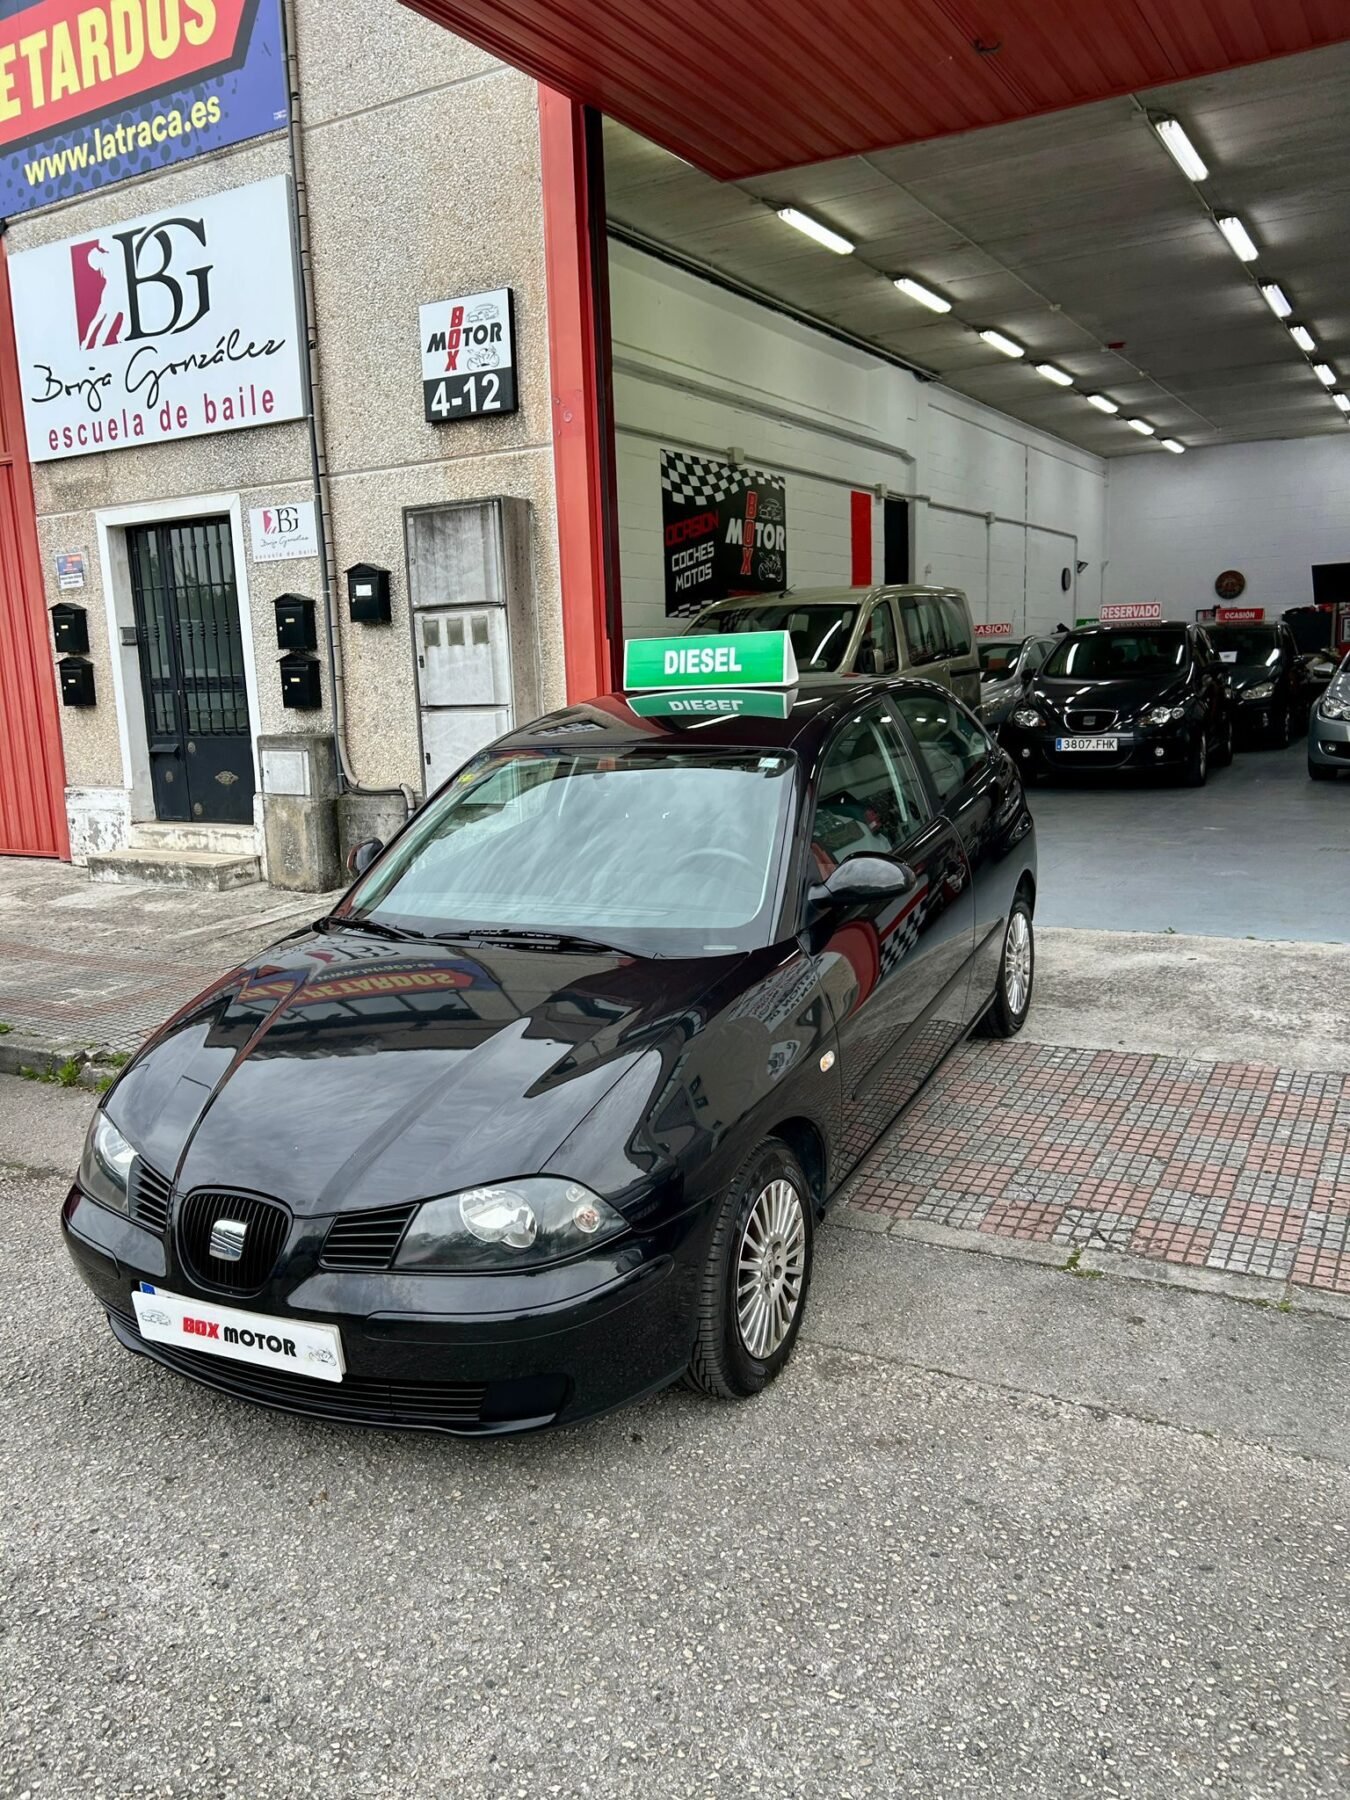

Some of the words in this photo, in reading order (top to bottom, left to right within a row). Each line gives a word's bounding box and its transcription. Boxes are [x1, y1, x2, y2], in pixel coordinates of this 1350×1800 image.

[24, 96, 221, 186] www.latraca.es
[112, 217, 213, 341] BG
[426, 322, 503, 353] MOTOR
[445, 306, 464, 372] BOX
[31, 364, 112, 412] Borja
[125, 328, 286, 409] González
[431, 373, 501, 417] 4-12
[49, 408, 144, 450] escuela
[159, 400, 188, 431] de
[203, 384, 274, 424] baile
[275, 506, 299, 533] BG
[725, 517, 785, 551] MOTOR
[671, 540, 715, 572] COCHES
[675, 562, 712, 592] MOTOS
[1101, 605, 1161, 619] RESERVADO
[664, 647, 742, 675] DIESEL
[182, 1317, 220, 1340] BOX
[223, 1326, 298, 1358] MOTOR
